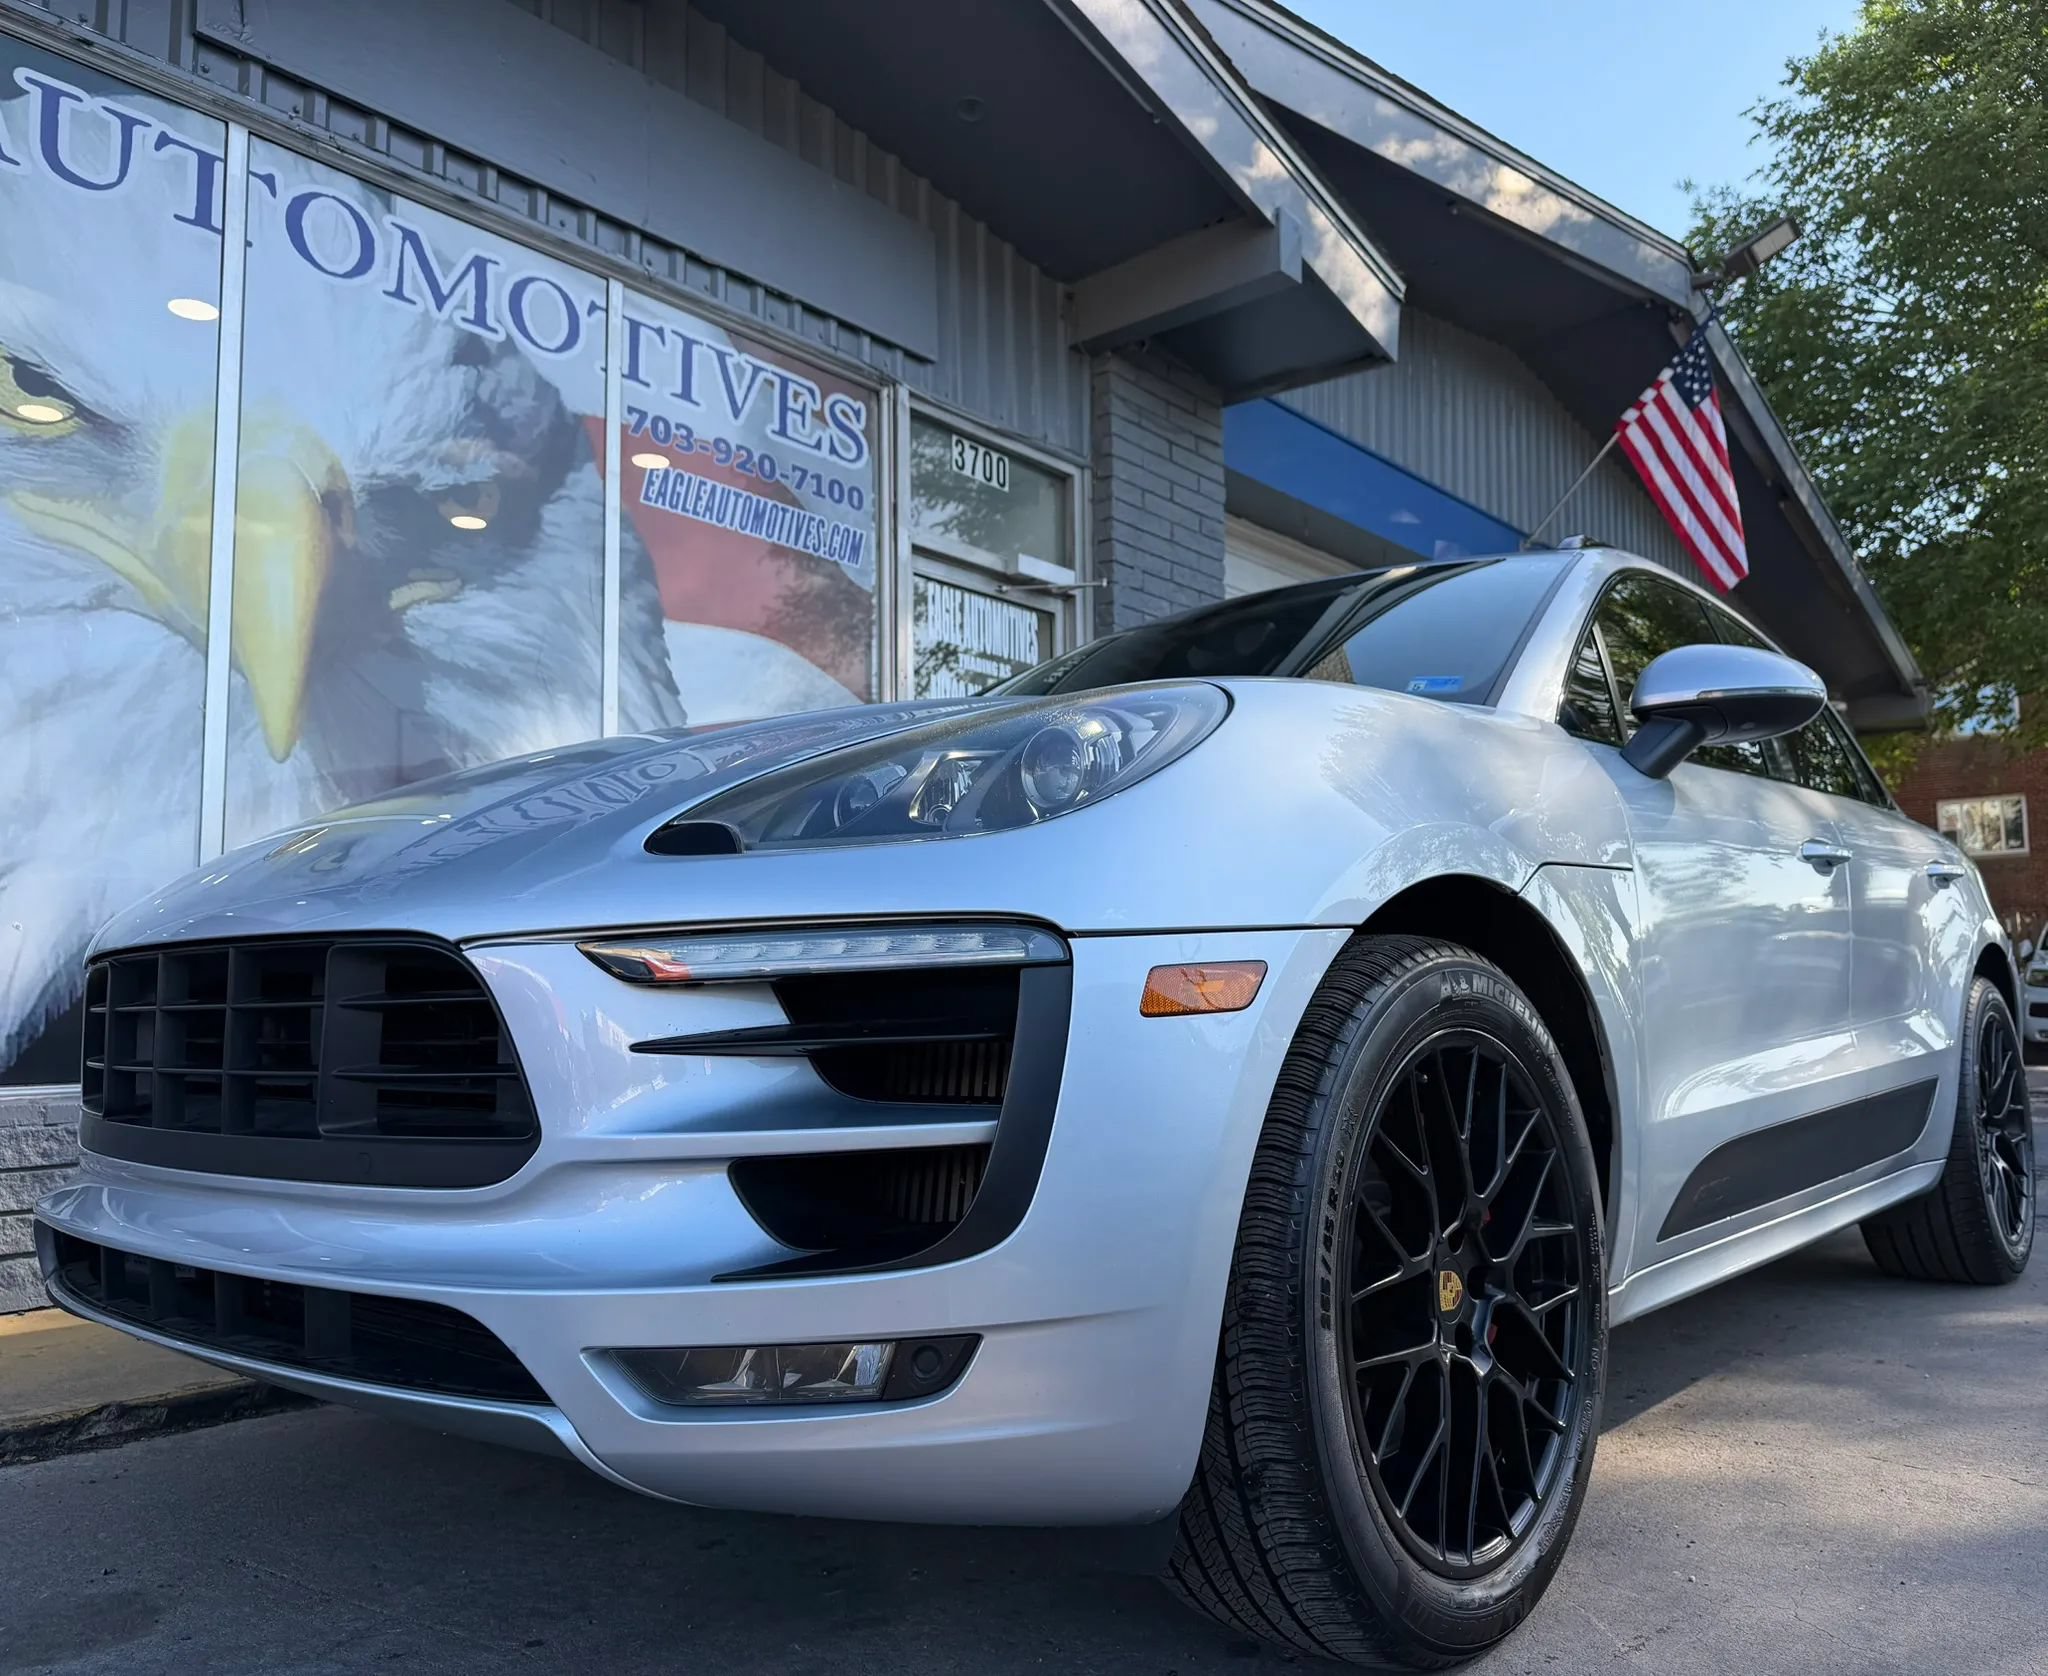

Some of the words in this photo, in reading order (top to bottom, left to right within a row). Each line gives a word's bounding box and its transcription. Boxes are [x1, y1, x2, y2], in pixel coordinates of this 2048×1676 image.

[0, 74, 866, 464] UTOMOTIVES
[626, 405, 866, 512] 703-920-7100
[954, 438, 1007, 489] 3700
[642, 469, 866, 567] EAGLEAUTOMOTIVES.COM
[1472, 973, 1549, 1047] MICHELIN
